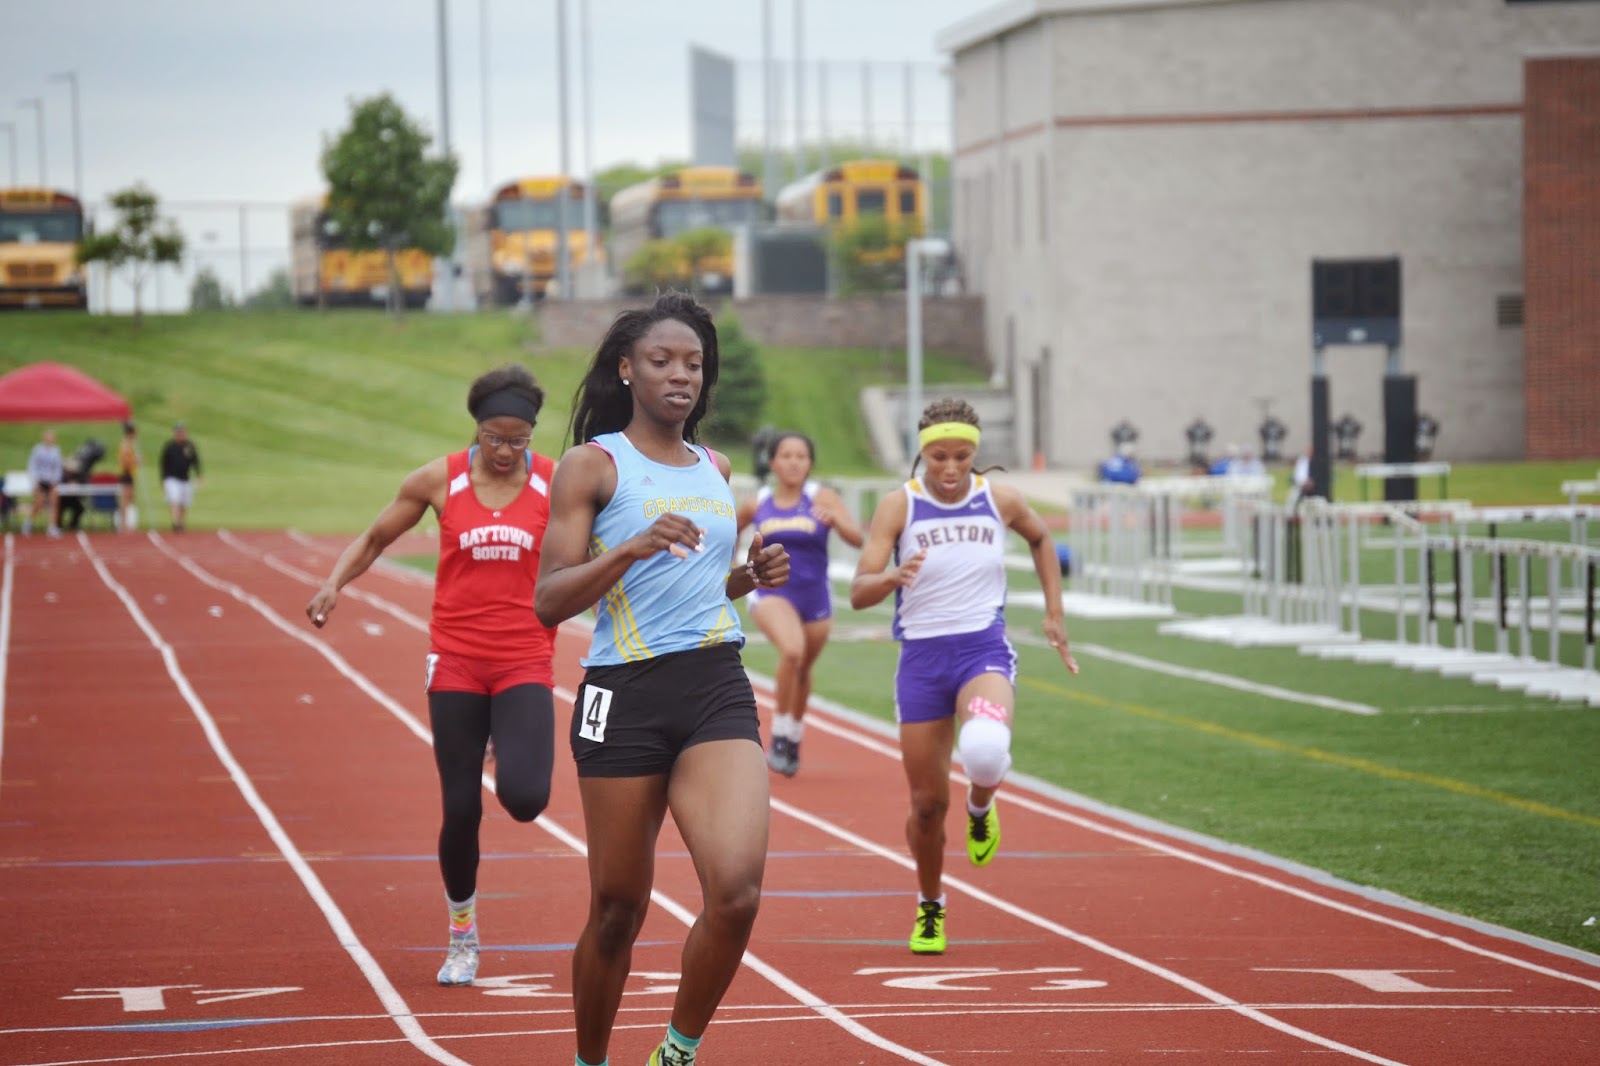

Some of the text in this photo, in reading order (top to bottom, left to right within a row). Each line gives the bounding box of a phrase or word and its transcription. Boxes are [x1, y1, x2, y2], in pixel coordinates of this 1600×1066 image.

[459, 525, 533, 551] RAYTOWN
[915, 524, 995, 548] BELTON
[472, 546, 519, 561] SOUTH
[586, 691, 603, 737] 4
